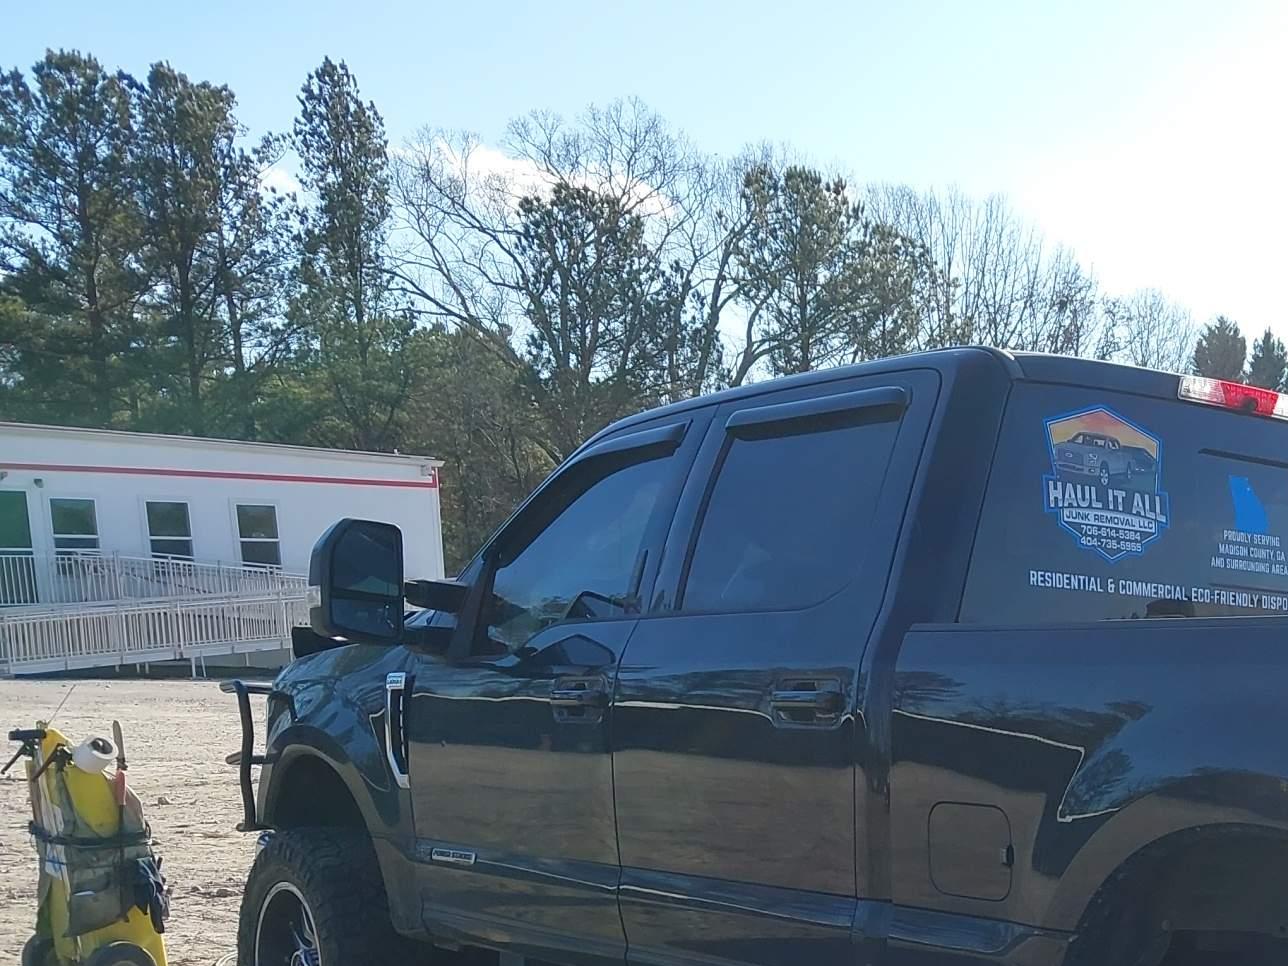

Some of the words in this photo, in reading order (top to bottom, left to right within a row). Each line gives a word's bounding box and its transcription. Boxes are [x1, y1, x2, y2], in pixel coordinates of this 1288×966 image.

[1048, 480, 1102, 508] HAUL
[1108, 488, 1126, 512] IT
[1132, 492, 1166, 523] ALL
[1065, 510, 1090, 521] JUNK
[1094, 513, 1136, 528] REMOVAL
[1138, 520, 1154, 530] LLC
[1224, 530, 1252, 544] PROUDLY
[1253, 534, 1280, 547] SERVING
[1218, 542, 1248, 557] MADISON
[1276, 552, 1286, 562] GA
[1211, 556, 1224, 569] AND
[1226, 558, 1270, 574] SURROUNDING
[1030, 570, 1104, 593] RESIDENTIAL
[1108, 578, 1115, 593] &
[1119, 580, 1188, 601] COMMERCIAL
[1192, 587, 1258, 608] ECO-FRIENDLY
